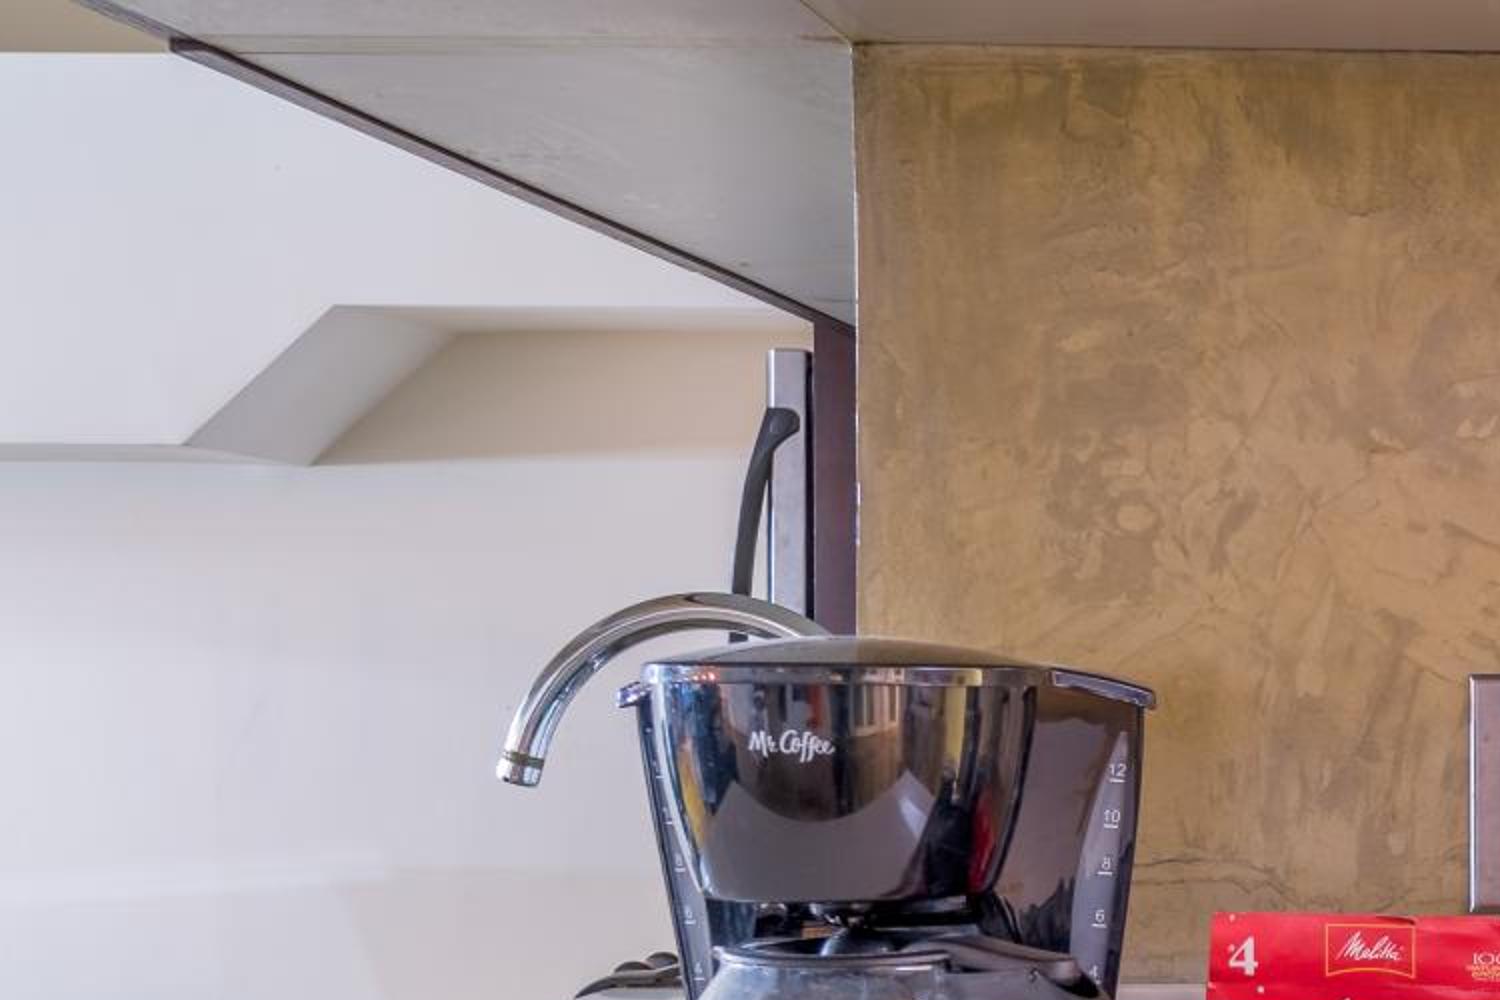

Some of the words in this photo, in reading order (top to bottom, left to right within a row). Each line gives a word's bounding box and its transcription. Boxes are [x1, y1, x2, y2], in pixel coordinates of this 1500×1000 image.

[779, 729, 836, 764] Coffee
[1108, 763, 1127, 778] 12
[1103, 809, 1121, 823] 10
[1094, 909, 1105, 922] 6
[1227, 936, 1259, 977] 4
[1335, 930, 1402, 962] Melitta
